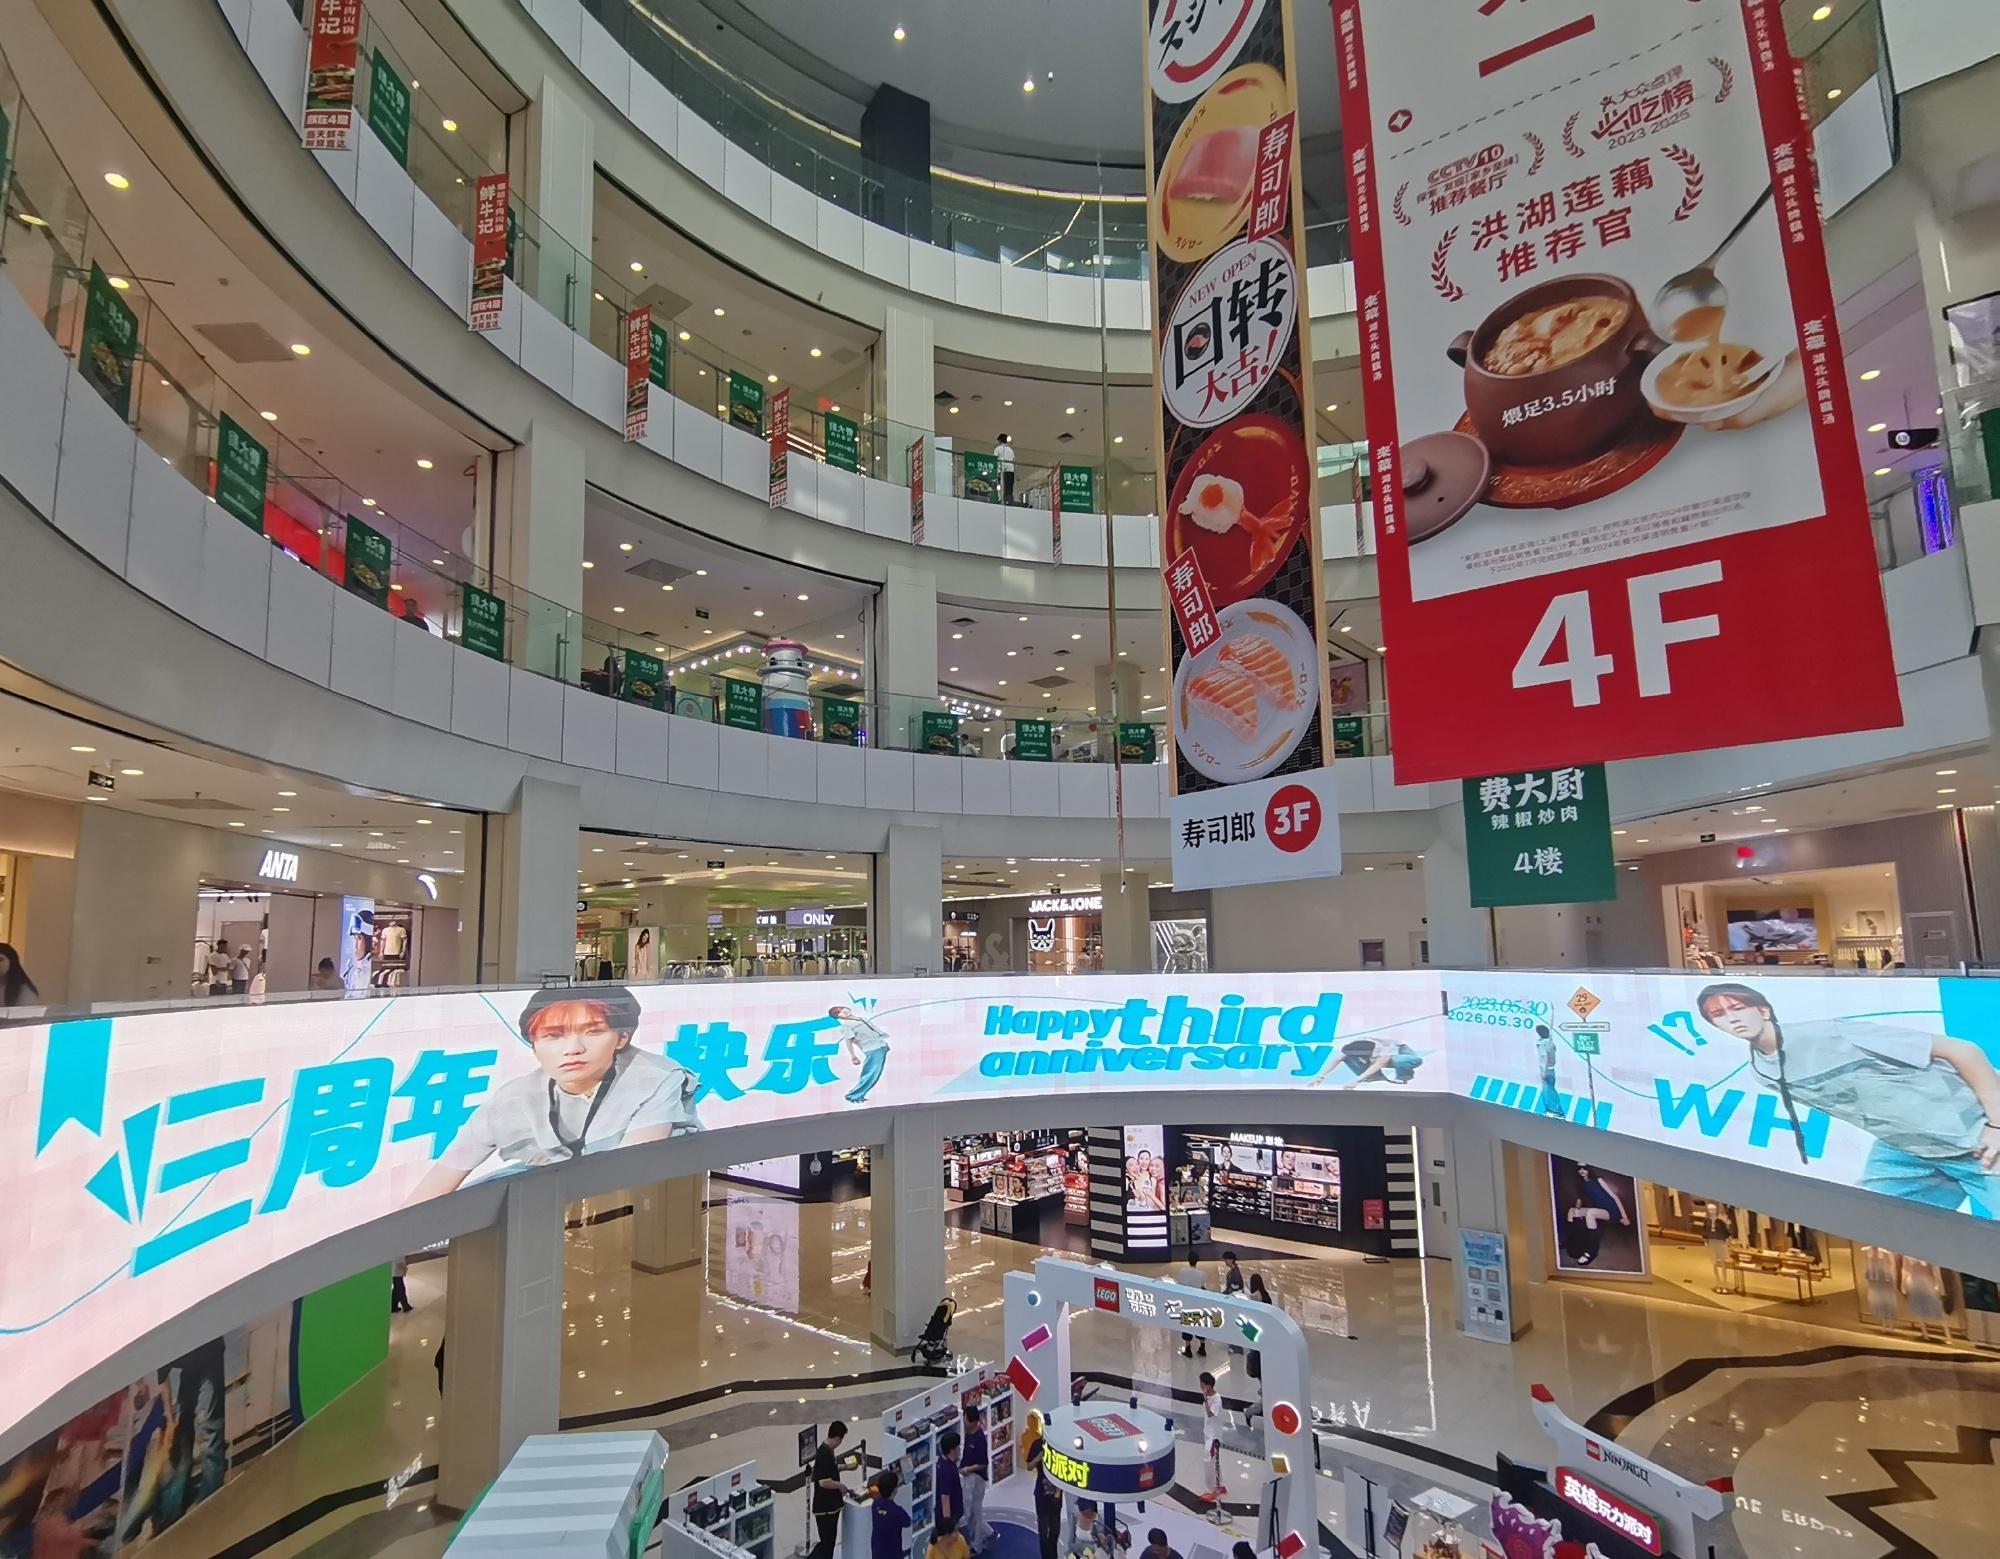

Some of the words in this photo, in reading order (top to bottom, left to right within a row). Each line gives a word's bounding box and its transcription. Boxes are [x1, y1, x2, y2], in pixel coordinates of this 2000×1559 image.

[1590, 79, 1695, 140] 必吃榜
[1608, 127, 1646, 150] 2023
[1650, 108, 1691, 134] 2025
[1255, 124, 1288, 234] 寿司郎
[1430, 170, 1508, 216] 推荐餐厅
[1471, 156, 1654, 250] 洪湖莲藕
[1496, 206, 1633, 283] 推荐官
[1188, 275, 1218, 308] NEW
[1222, 248, 1258, 282] OPEN
[1174, 256, 1294, 390] 回转
[1501, 376, 1618, 428] 煨足3.5小时
[1171, 560, 1214, 649] 寿司郎
[1511, 558, 1722, 707] 4F
[1479, 766, 1585, 813] 费大厨
[1181, 811, 1256, 850] 寿司郎
[1272, 801, 1311, 835] 3F
[1490, 806, 1578, 831] 辣椒炒肉
[259, 849, 299, 882] ANTA
[1513, 846, 1564, 876] 4楼
[803, 913, 834, 925] ONLY
[983, 1004, 1117, 1042] Happy
[1116, 992, 1341, 1046] third
[1447, 1011, 1534, 1030] 2026.05.30
[979, 1037, 1335, 1078] anniversary
[1230, 1132, 1264, 1144] MAKEUP
[1654, 1078, 1832, 1159] WH
[131, 1049, 498, 1278] 三周年
[666, 1016, 841, 1104] 快乐
[1096, 1287, 1117, 1304] LEGO
[1602, 1448, 1652, 1487] NINJAGO
[1564, 1475, 1652, 1545] 英雄玩力派对
